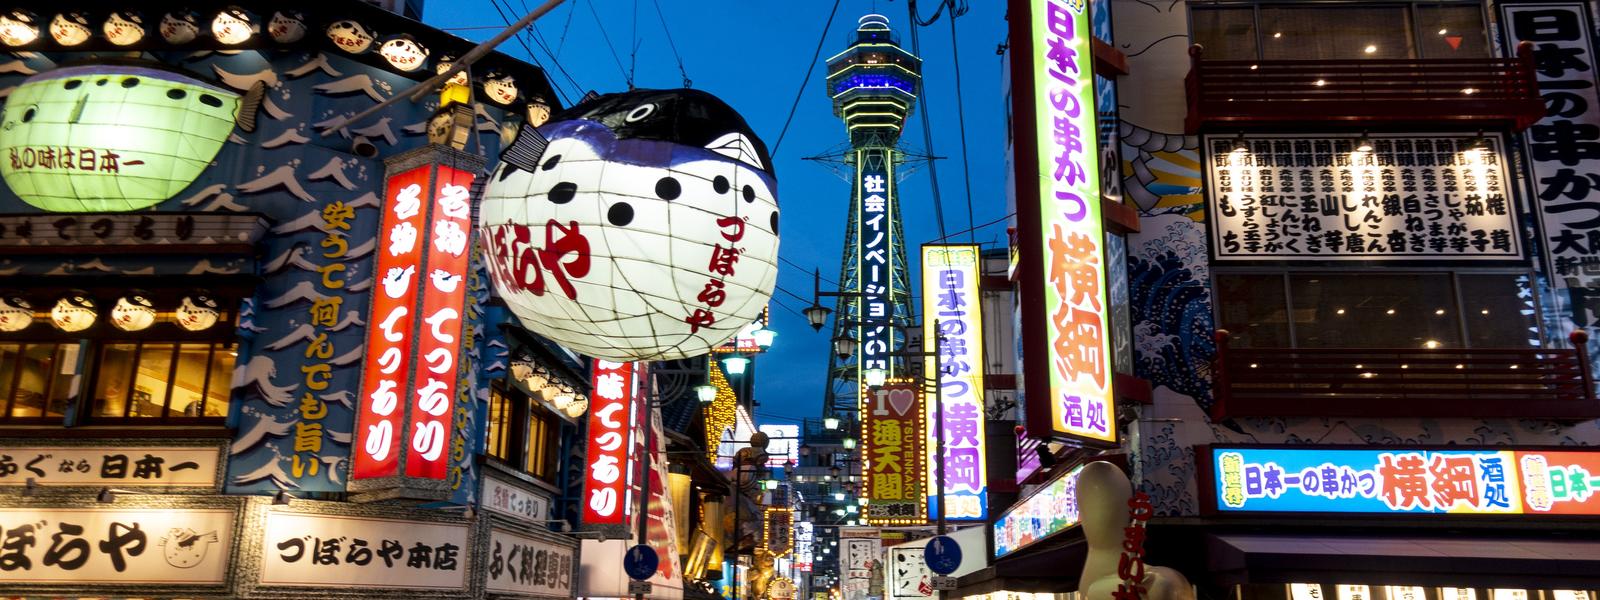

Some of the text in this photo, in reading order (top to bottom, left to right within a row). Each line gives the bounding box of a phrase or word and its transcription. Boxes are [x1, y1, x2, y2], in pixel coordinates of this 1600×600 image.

[1047, 1, 1086, 222] 日本一の串かつ
[1219, 194, 1240, 253] もち
[1240, 194, 1263, 253] うずら玉子
[1260, 194, 1283, 253] 紅しょうが
[1279, 194, 1301, 253] にんにく
[1301, 194, 1323, 253] 玉ねぎ
[1320, 194, 1344, 253] 山芋
[1342, 194, 1365, 253] しし唐
[1362, 194, 1386, 253] れんこん
[1382, 194, 1406, 253] 銀杏
[1403, 194, 1427, 253] 白ねぎ
[1424, 194, 1448, 253] さつま芋
[1444, 194, 1470, 253] じゃが芋
[1465, 194, 1490, 253] 茄子
[1485, 194, 1511, 253] 椎茸
[686, 215, 750, 333] づぼらや
[1049, 224, 1105, 390] 横綱
[873, 389, 890, 416] I
[1063, 393, 1106, 432] 酒処
[873, 419, 902, 500] 通天閣
[904, 419, 914, 500] TSUTENKAKU
[932, 402, 980, 491] 横綱
[1223, 455, 1509, 508] 新世界 日本一の串かつ 横綱 酒処
[277, 535, 460, 570] づぼらや本店
